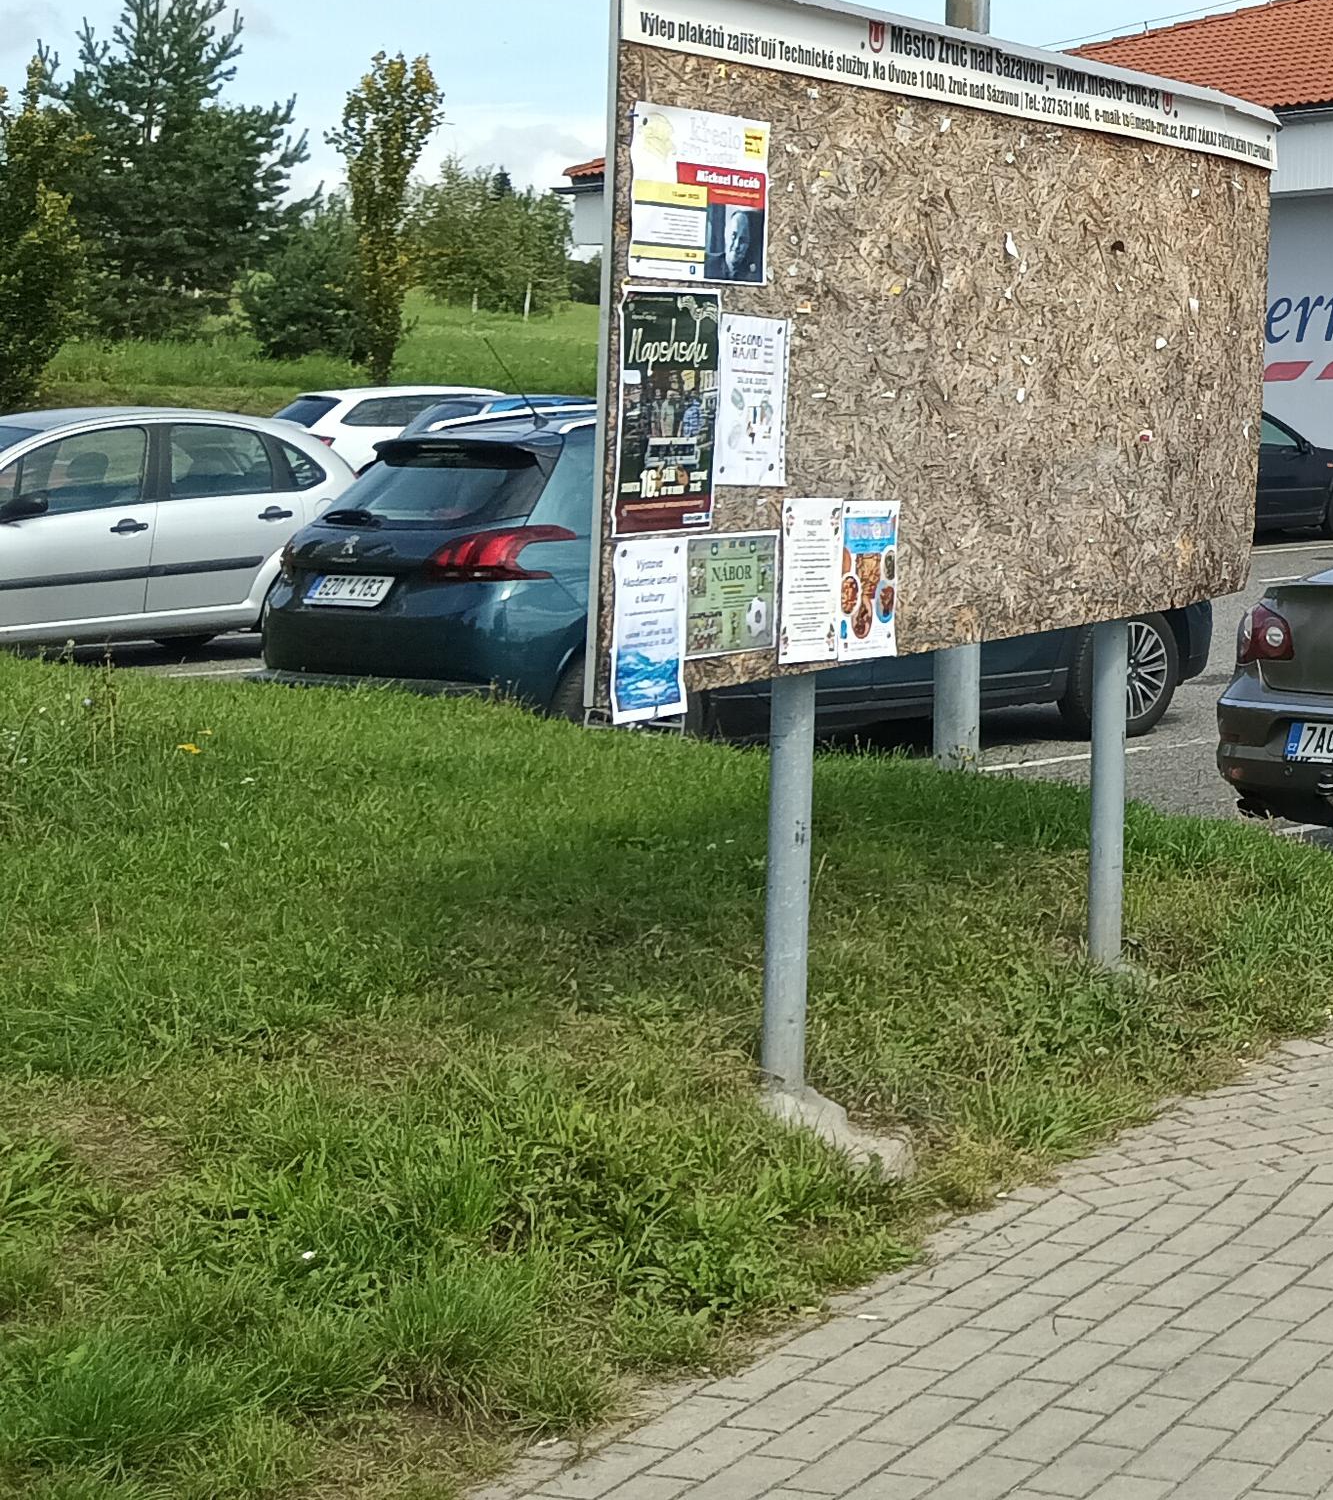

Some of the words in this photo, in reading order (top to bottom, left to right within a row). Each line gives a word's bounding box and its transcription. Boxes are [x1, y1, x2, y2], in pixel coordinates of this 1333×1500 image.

[640, 11, 675, 41] Výlep
[678, 21, 724, 49] plakátů
[727, 32, 776, 60] zajišťují
[778, 40, 834, 71] Technické
[837, 55, 871, 80] služby,
[873, 61, 886, 82] Na
[888, 60, 918, 87] Úvoze
[948, 75, 968, 97] Zruč
[970, 80, 985, 101] nad
[987, 84, 1019, 108] Sázavou
[1041, 95, 1056, 115] 327
[1057, 99, 1073, 118] 531
[890, 26, 935, 61] Město
[938, 36, 967, 68] Zruč
[970, 45, 993, 74] nad
[711, 563, 753, 582] NÁBOR
